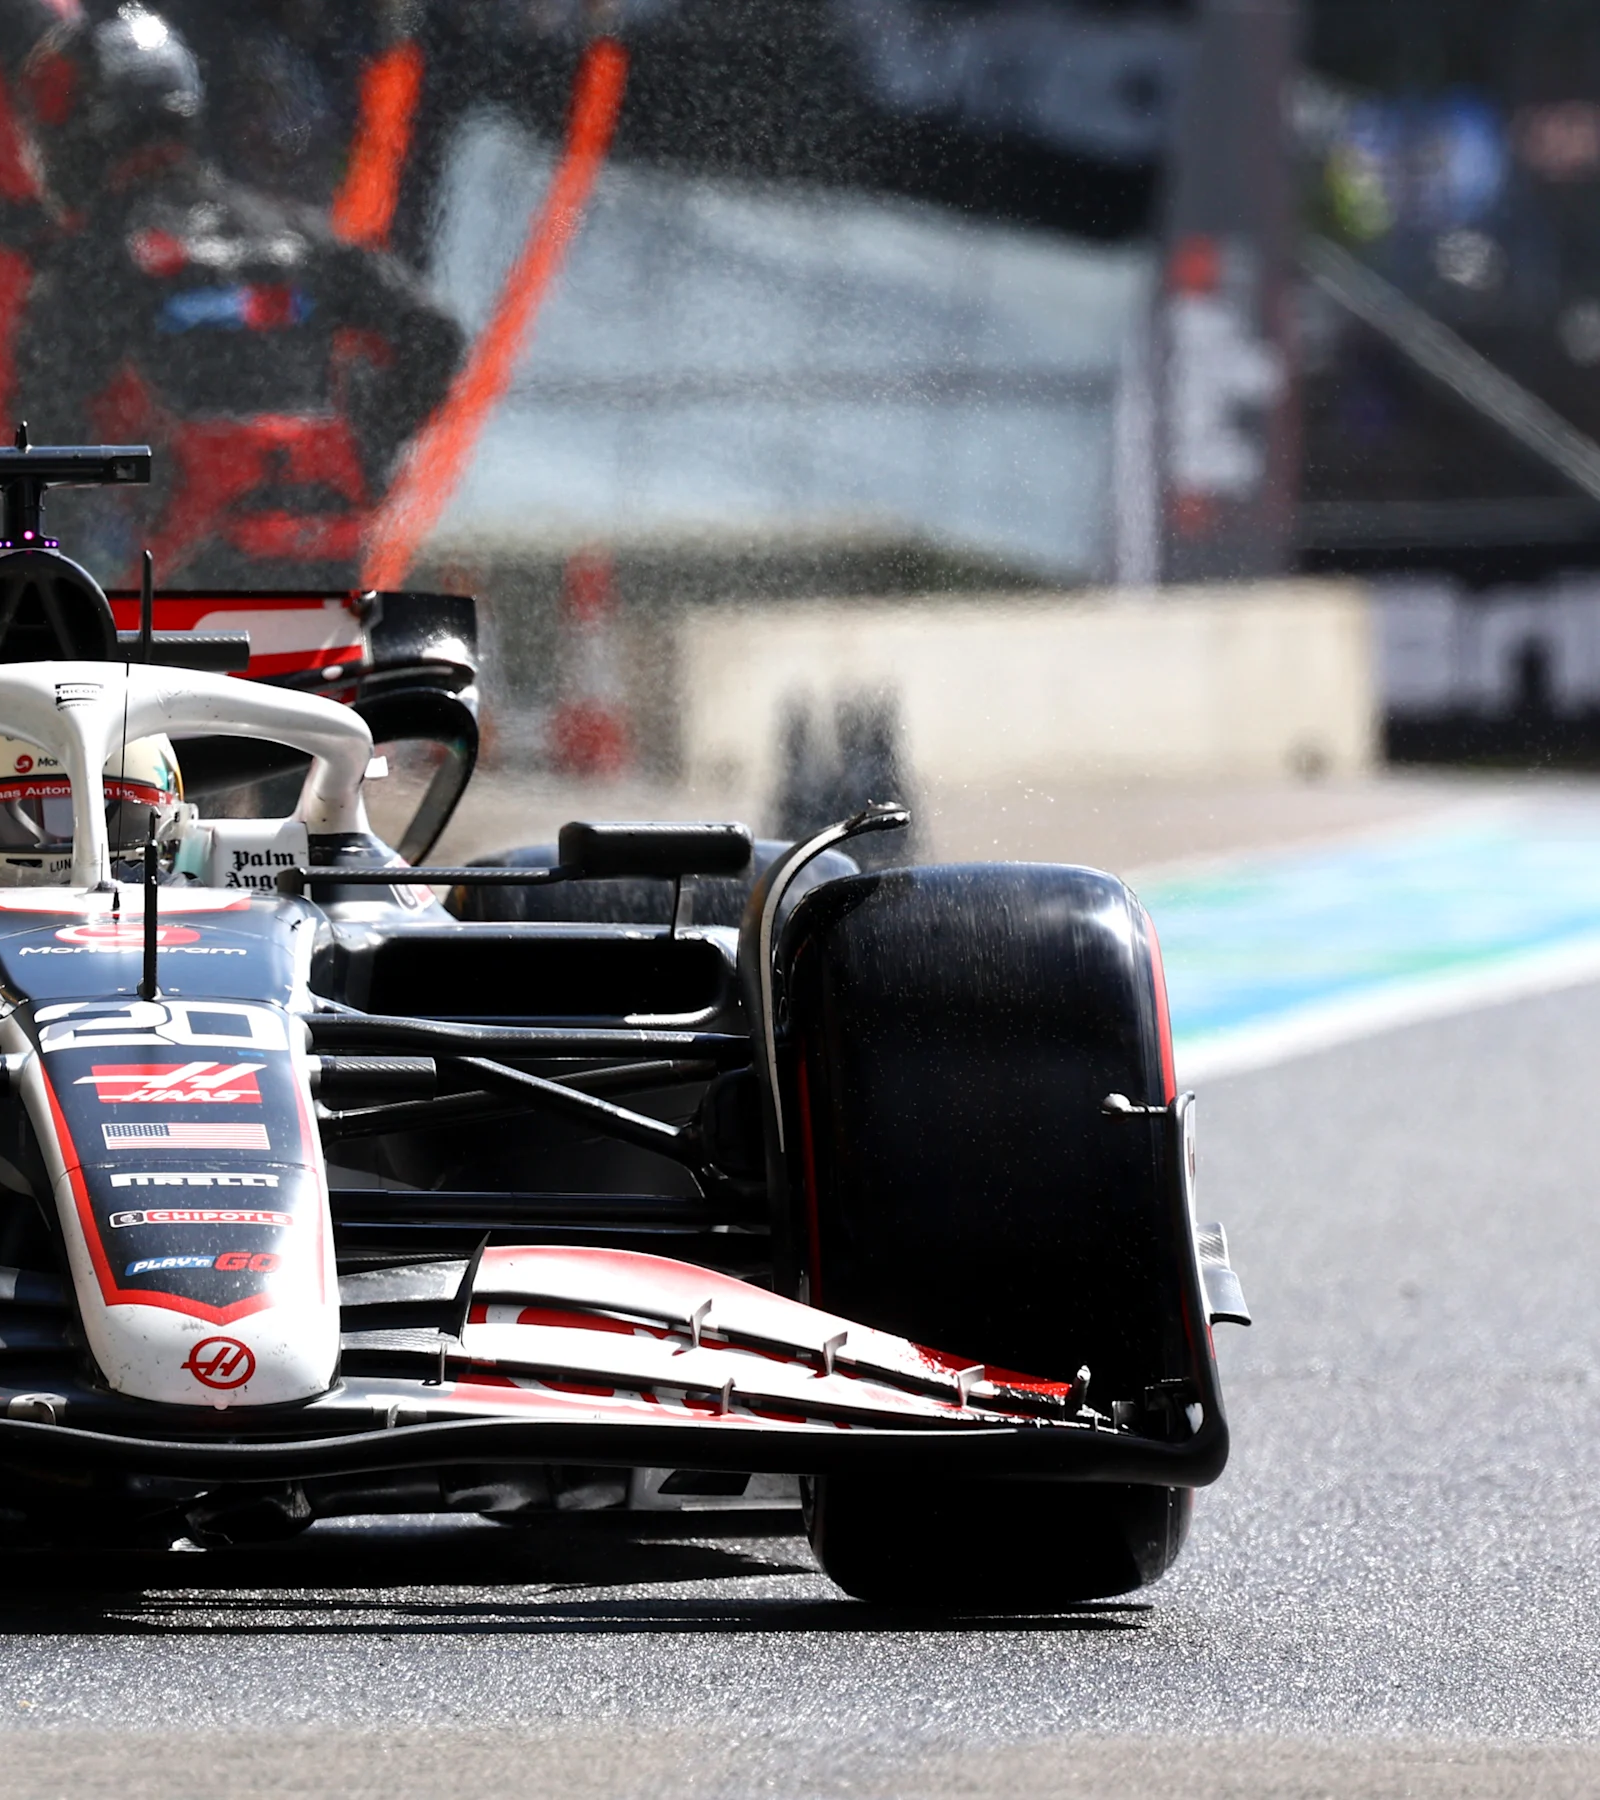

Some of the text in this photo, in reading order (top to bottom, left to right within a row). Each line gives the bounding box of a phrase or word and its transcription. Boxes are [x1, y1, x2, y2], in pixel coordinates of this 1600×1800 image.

[116, 786, 139, 799] Inc.
[232, 848, 296, 871] Palm
[34, 1000, 289, 1053] 20
[120, 1089, 242, 1102] HAAS
[110, 1173, 280, 1188] PIRELLI
[152, 1210, 290, 1225] CHIPOTLE
[214, 1251, 283, 1272] GO
